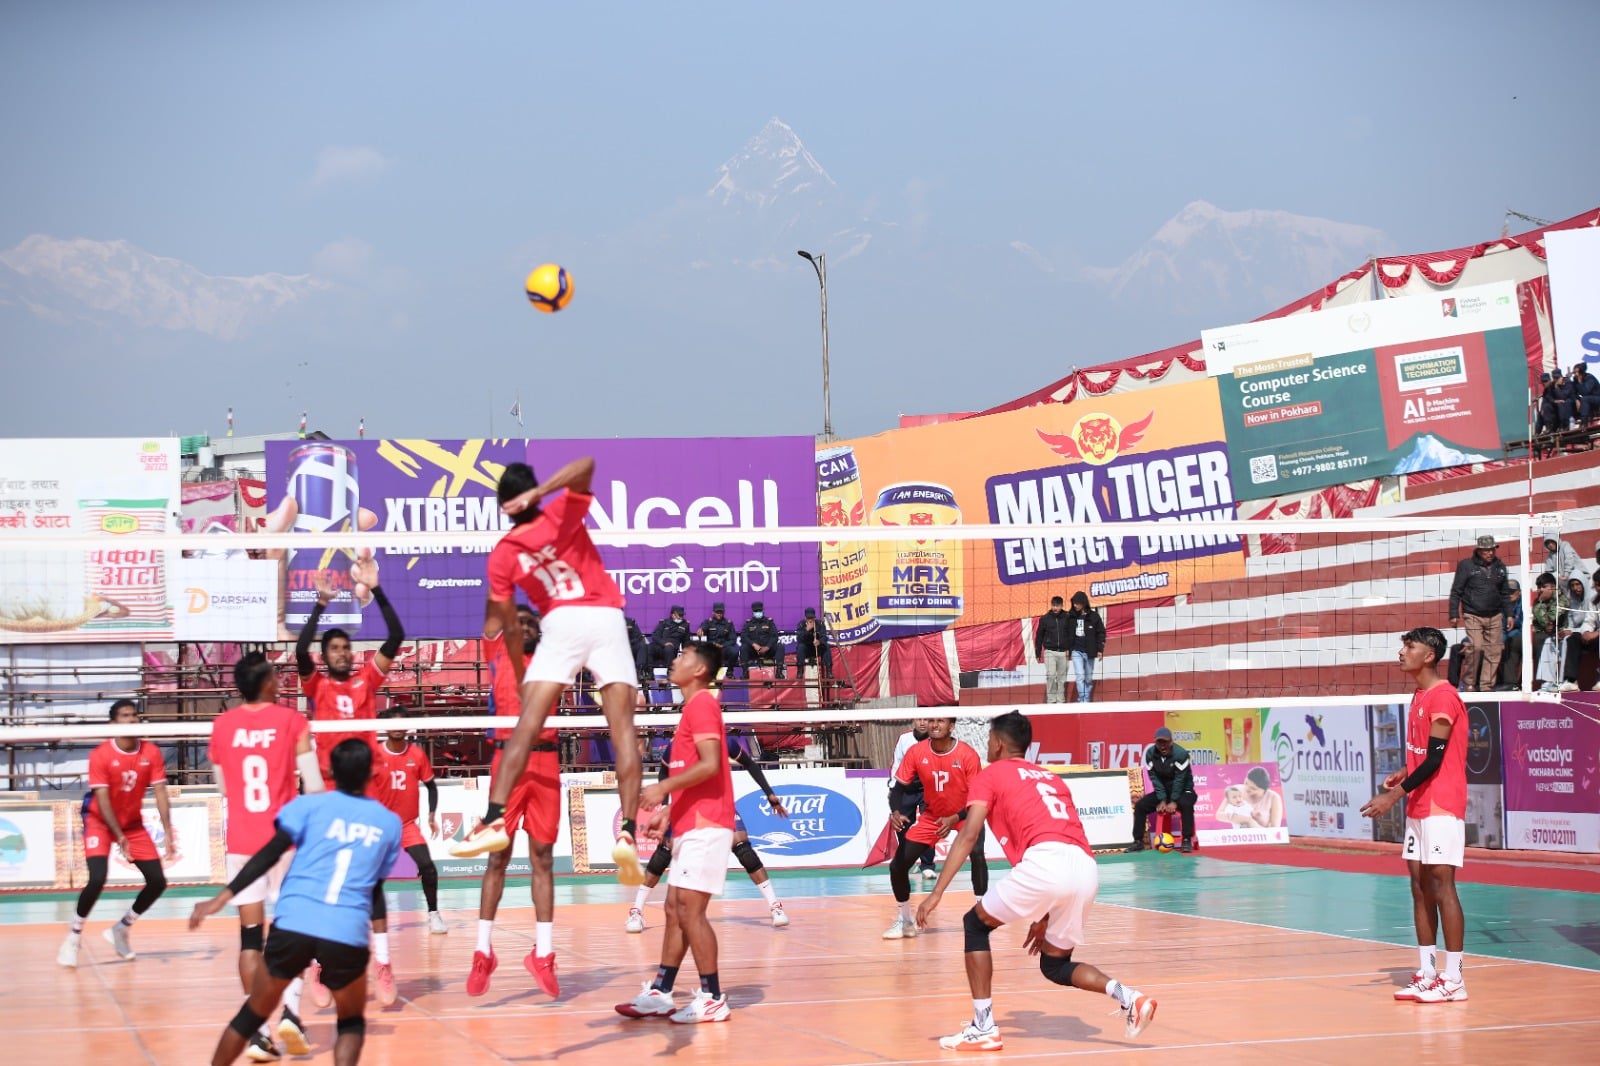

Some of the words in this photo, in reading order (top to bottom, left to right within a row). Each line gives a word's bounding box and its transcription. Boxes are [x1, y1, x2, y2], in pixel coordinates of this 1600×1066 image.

[1237, 366, 1254, 376] The
[1254, 356, 1309, 373] Most-Trusted
[1404, 359, 1457, 372] INFORMATION
[1406, 366, 1457, 379] TECHNOLOGY
[1240, 373, 1309, 393] Computer
[1313, 362, 1367, 382] Science
[1242, 391, 1291, 408] Course
[1403, 397, 1425, 419] AI
[1247, 413, 1269, 424] Now
[1270, 411, 1279, 420] in
[1281, 404, 1318, 418] Pokhara
[820, 458, 849, 476] CAN
[1292, 461, 1336, 476] +977-9802
[1337, 456, 1368, 469] 851717
[994, 470, 1103, 525] MAX
[1107, 450, 1234, 520] TIGER
[33, 516, 72, 528] आटा
[584, 479, 779, 547] Ncell
[1003, 536, 1126, 577] ENERGY
[1139, 507, 1241, 556] DRINK
[101, 566, 160, 585] आटा
[418, 578, 482, 589] #goxtreme
[702, 560, 780, 593] लागि
[893, 566, 950, 583] MAX
[892, 584, 951, 595] TIGER
[1091, 573, 1168, 596] #mymaxtiger
[211, 595, 267, 605] DARSHAN
[889, 597, 924, 607] ENERGY
[927, 597, 952, 606] DRINK
[336, 695, 354, 714] 9
[232, 729, 277, 748] APF
[1527, 744, 1573, 767] vatsalya
[390, 770, 407, 790] 12
[931, 770, 950, 792] 17
[1017, 768, 1055, 780] APF
[1528, 767, 1554, 777] POKHARA
[1555, 767, 1573, 777] CLINIC
[242, 754, 271, 813] 8
[1036, 782, 1070, 819] 6
[1305, 789, 1349, 808] AUSTRALIA
[325, 818, 384, 848] APF
[788, 818, 825, 836] दूध
[1221, 834, 1267, 843] 9701021111
[1407, 835, 1415, 854] 2
[1532, 829, 1576, 846] 9701021111
[324, 848, 353, 905] 1
[442, 866, 473, 874] Mustang
